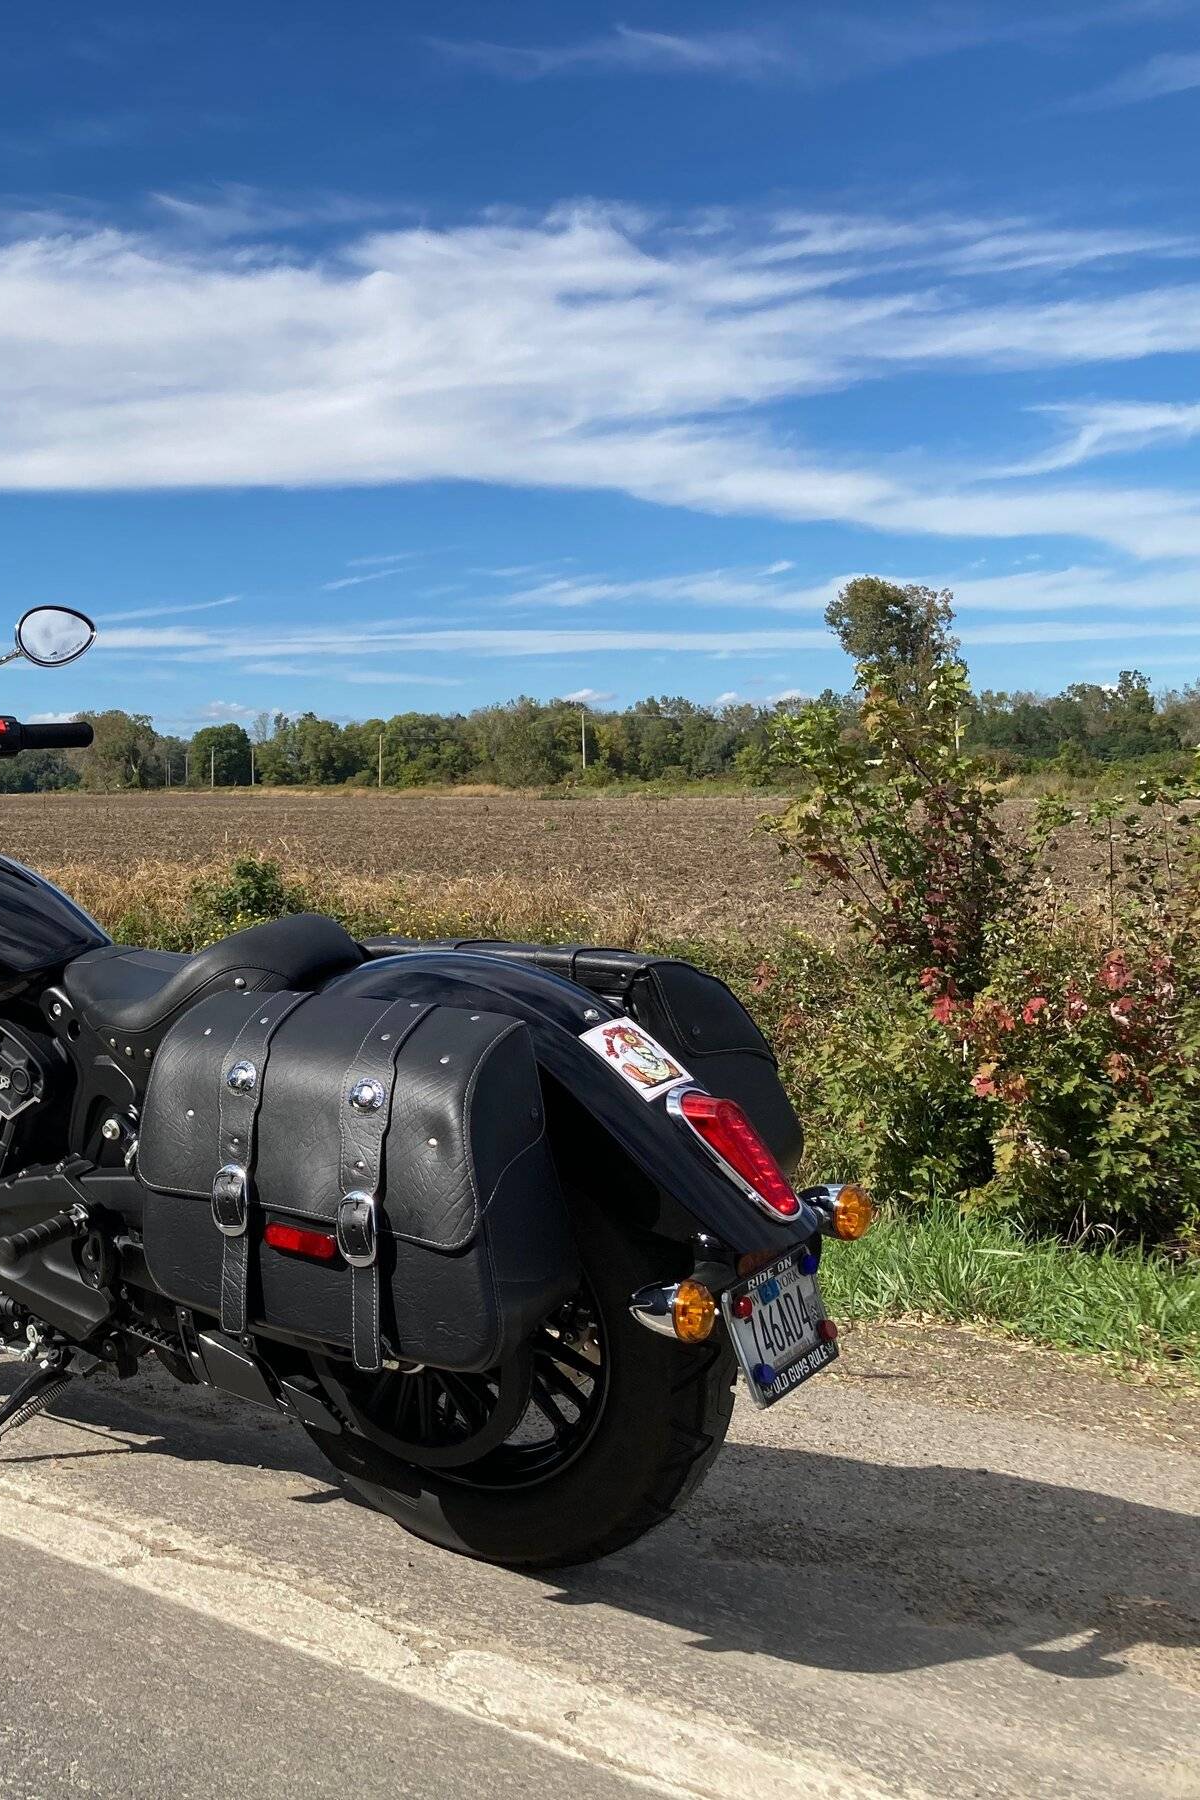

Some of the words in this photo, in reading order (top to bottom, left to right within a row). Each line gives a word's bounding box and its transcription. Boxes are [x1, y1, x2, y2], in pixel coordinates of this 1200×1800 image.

[747, 1267, 775, 1291] RIDE
[777, 1256, 792, 1272] ON
[772, 1373, 789, 1394] OLD
[788, 1358, 810, 1382] GUYS
[808, 1344, 828, 1369] RULE
